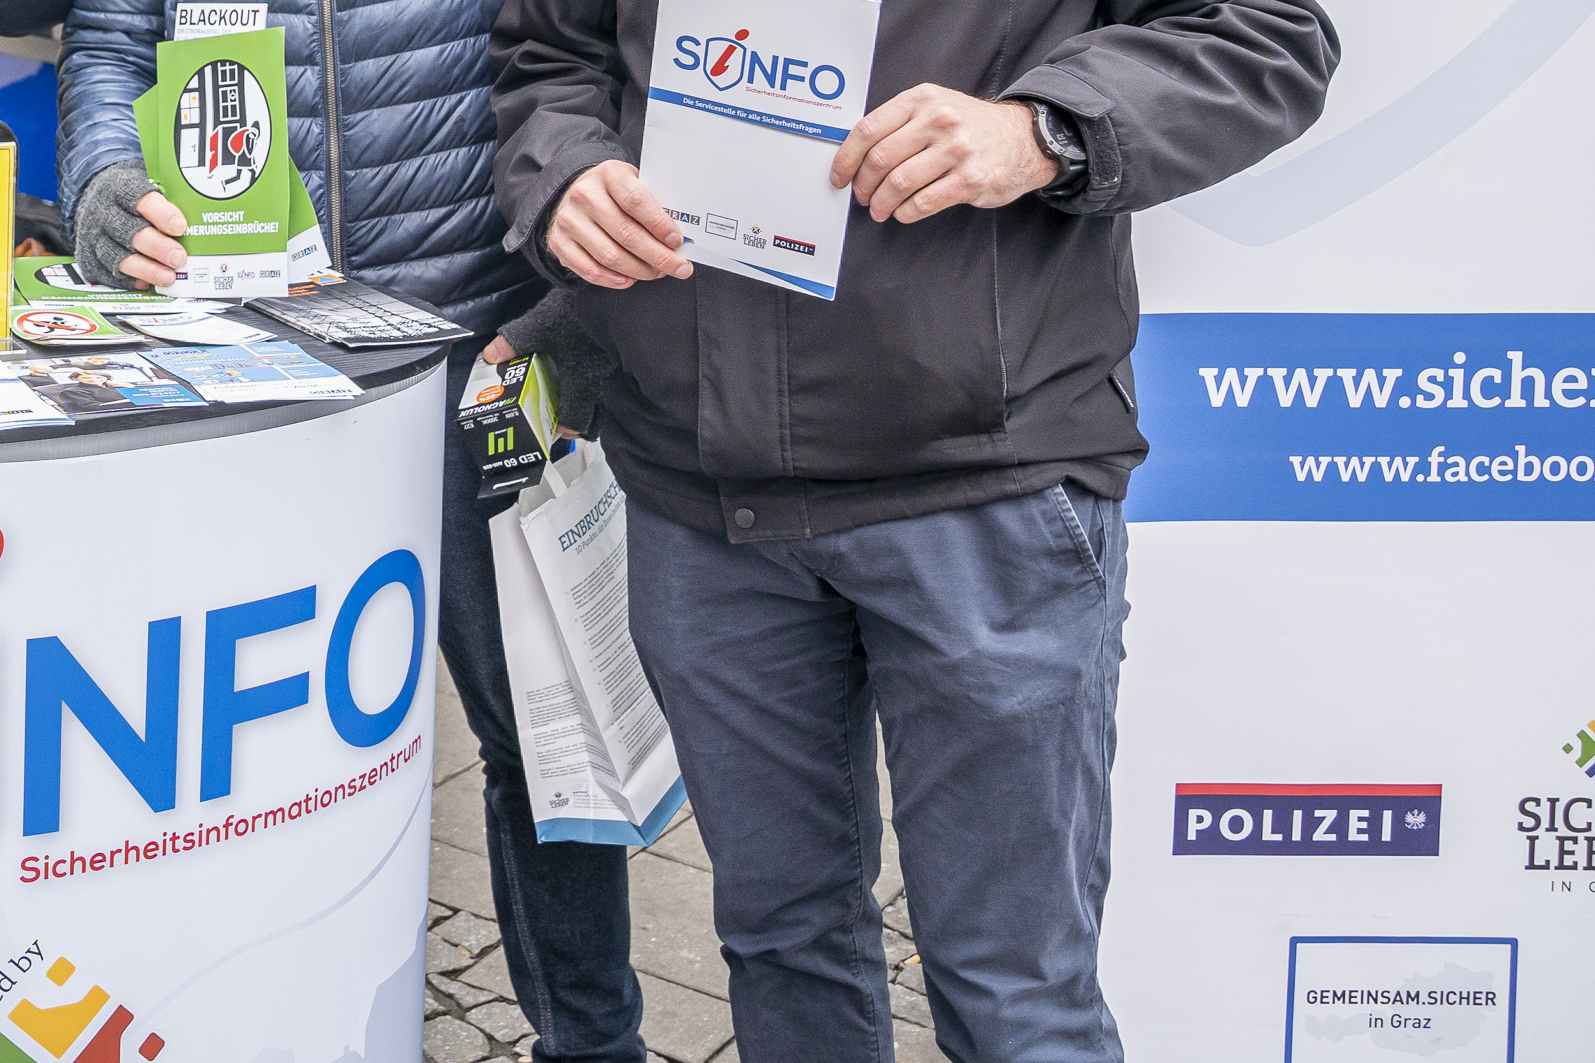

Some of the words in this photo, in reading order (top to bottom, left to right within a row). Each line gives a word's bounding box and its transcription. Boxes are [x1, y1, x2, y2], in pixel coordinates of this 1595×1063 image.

[179, 8, 260, 26] BLACKOUT
[745, 86, 843, 111] Sicherheitsinformationszentrum
[683, 97, 695, 106] Die
[695, 100, 736, 116] Servicestelle
[736, 109, 748, 119] für
[748, 112, 761, 121] alle
[761, 115, 822, 134] Sicherheitsfragen
[202, 211, 245, 223] VORSICHT
[743, 233, 767, 245] SICHER
[774, 239, 809, 252] POLIZEI
[743, 239, 765, 249] LEBEN
[502, 376, 524, 386] LED
[1199, 350, 1595, 409] www.siche
[504, 457, 518, 468] 60
[519, 451, 542, 464] LED
[19, 734, 422, 883] Sicherheitsinformationszentrum
[1517, 796, 1593, 833] SIC
[1187, 808, 1393, 842] POLIZEI
[1551, 880, 1572, 893] IN
[7, 939, 44, 974] by
[1306, 990, 1497, 1006] GEMEINSAM.SICHER
[1368, 1014, 1384, 1029] in
[1390, 1014, 1432, 1029] Graz
